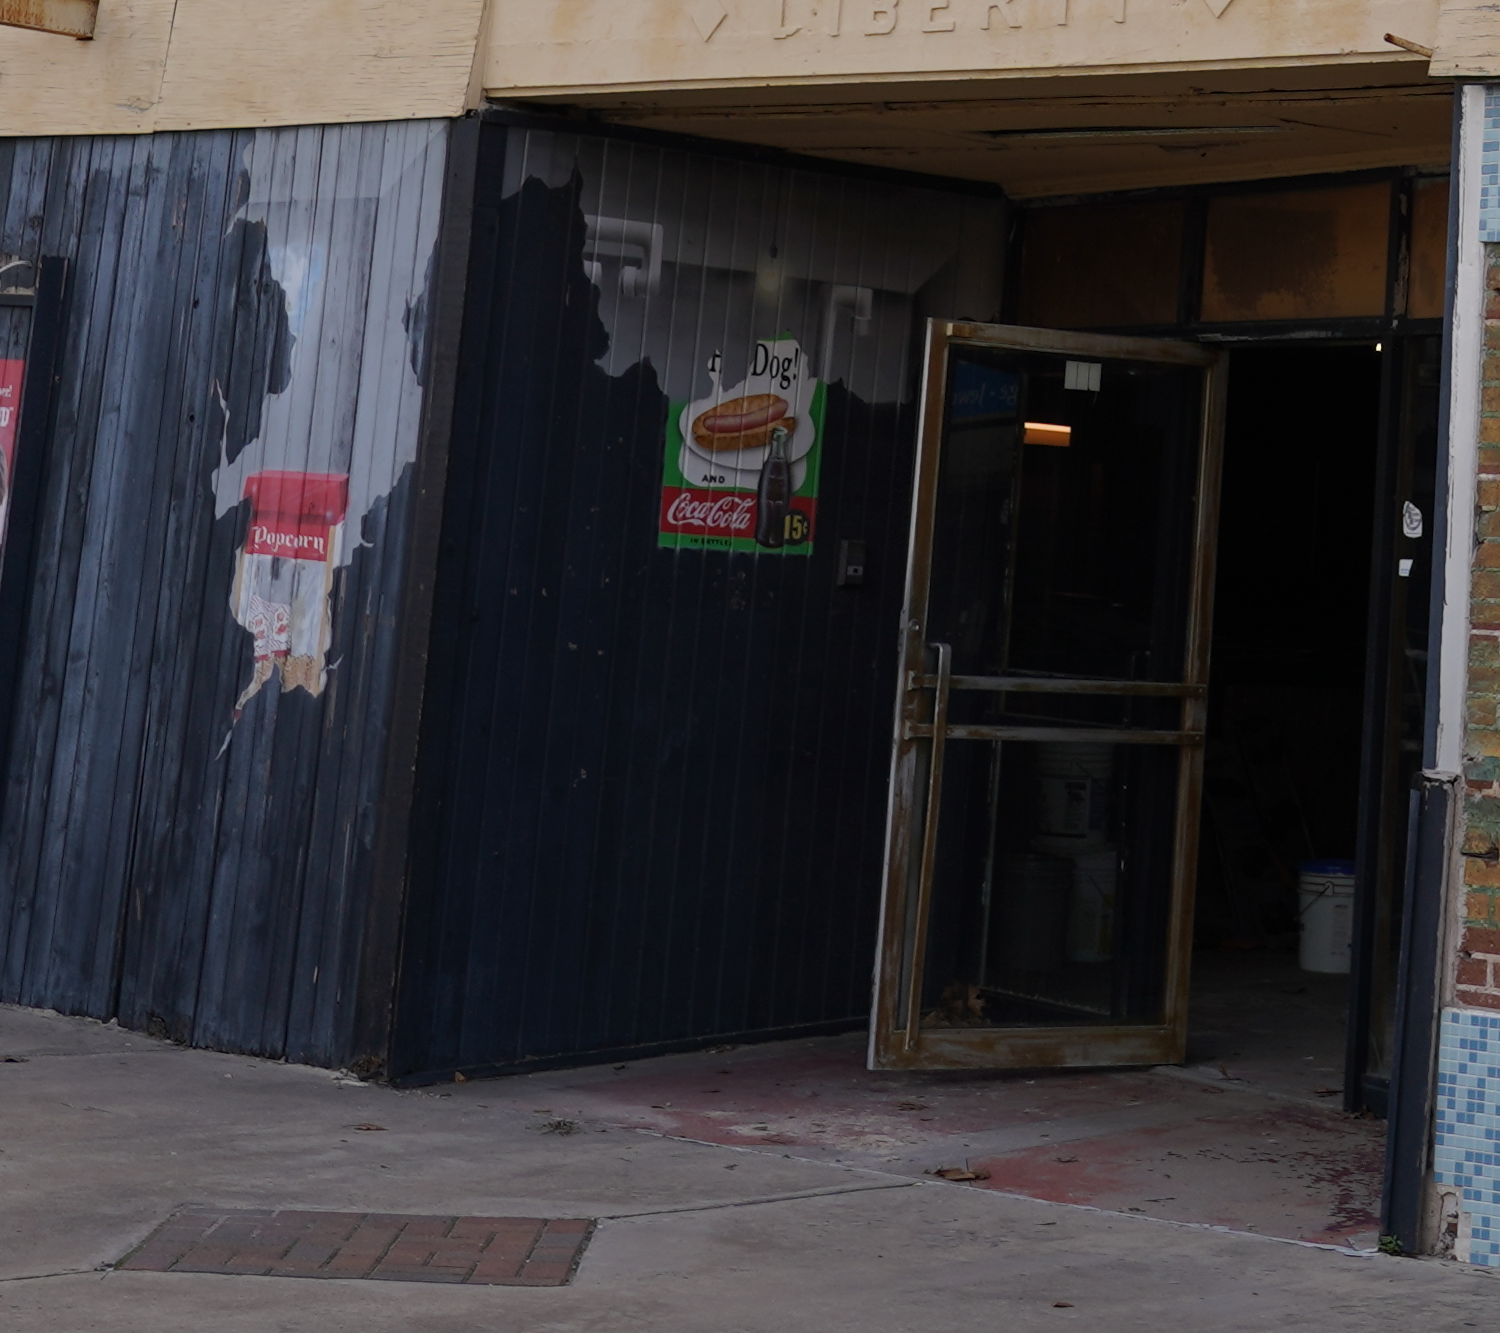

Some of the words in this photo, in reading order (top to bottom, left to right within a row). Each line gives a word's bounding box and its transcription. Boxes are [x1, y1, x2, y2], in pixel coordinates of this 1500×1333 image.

[751, 342, 800, 391] Dog!
[701, 474, 726, 484] AND
[251, 525, 326, 555] Popcorn
